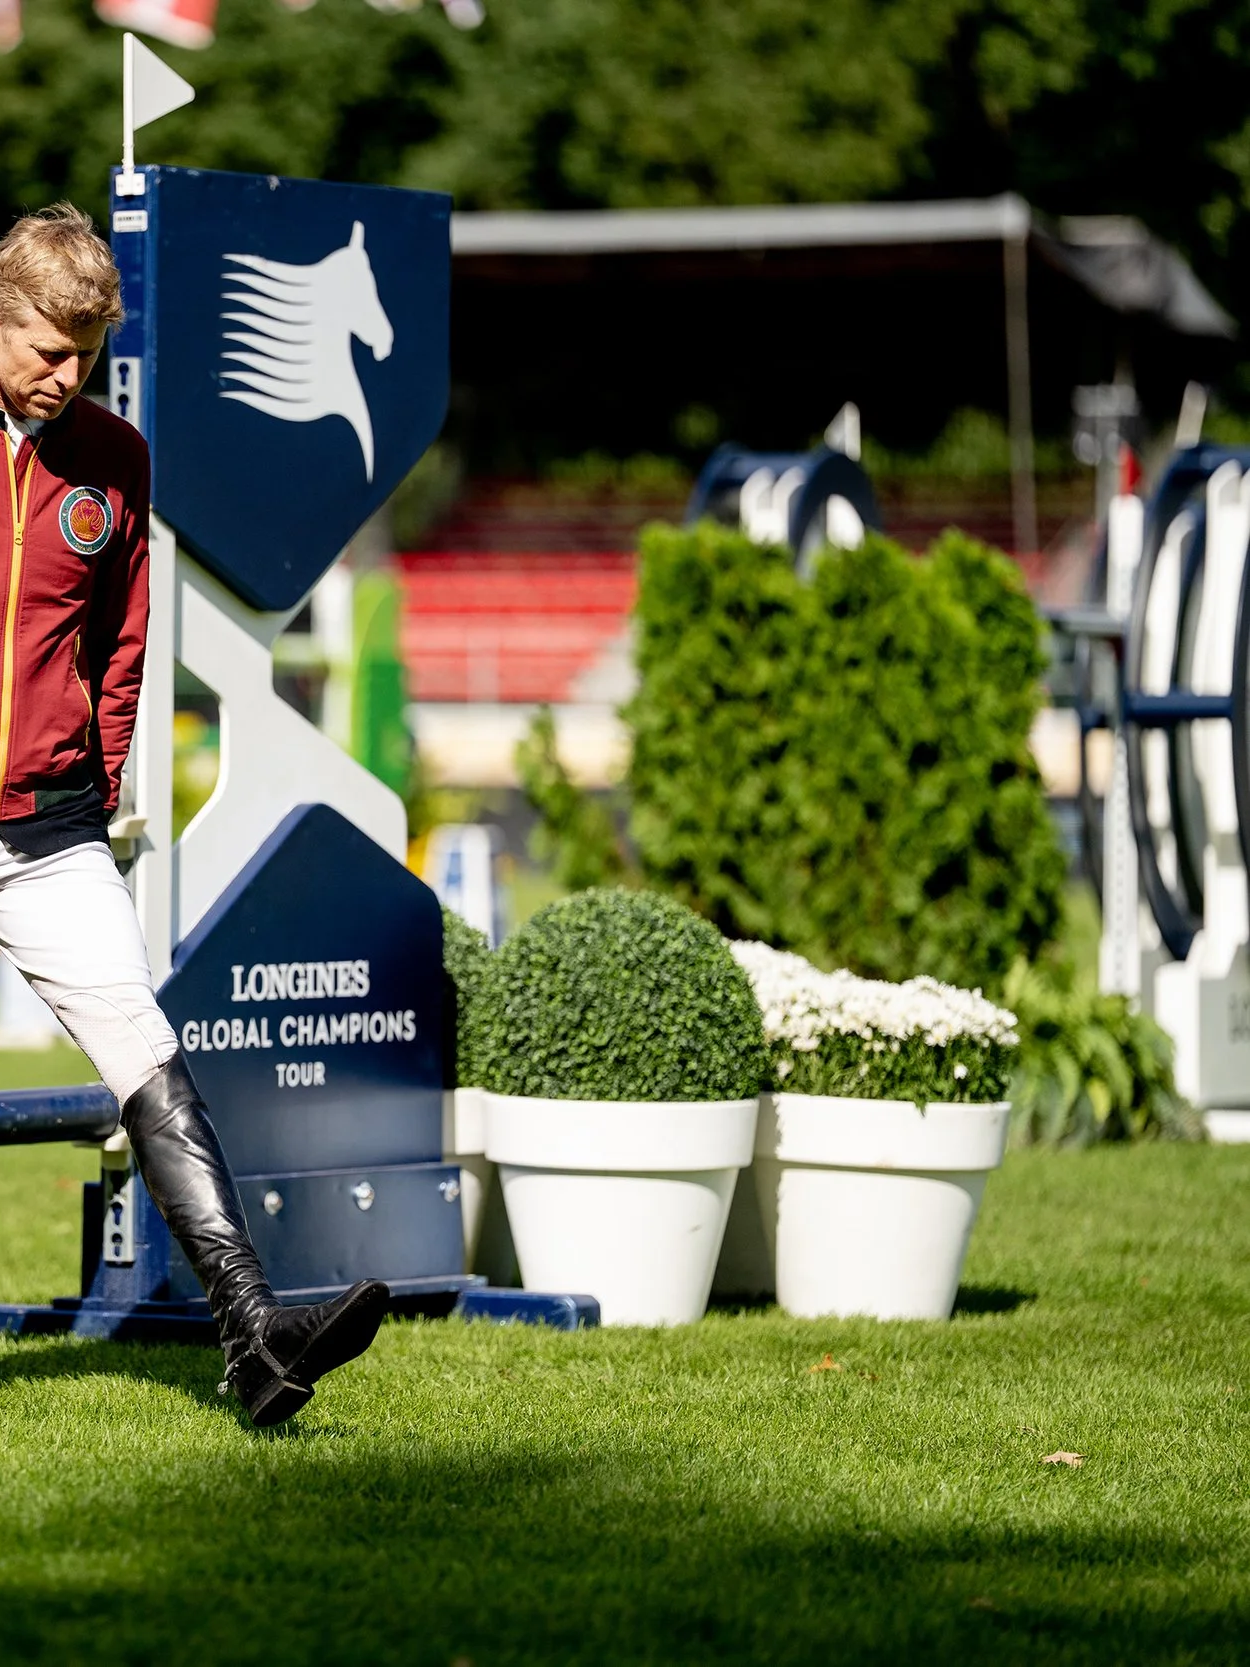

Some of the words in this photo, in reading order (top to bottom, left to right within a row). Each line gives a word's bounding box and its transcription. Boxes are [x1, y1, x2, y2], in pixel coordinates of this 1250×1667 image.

[231, 959, 370, 1002] LONGINES
[182, 1016, 273, 1052] GLOBAL
[279, 1009, 417, 1047] CHAMPIONS
[275, 1061, 326, 1088] TOUR
